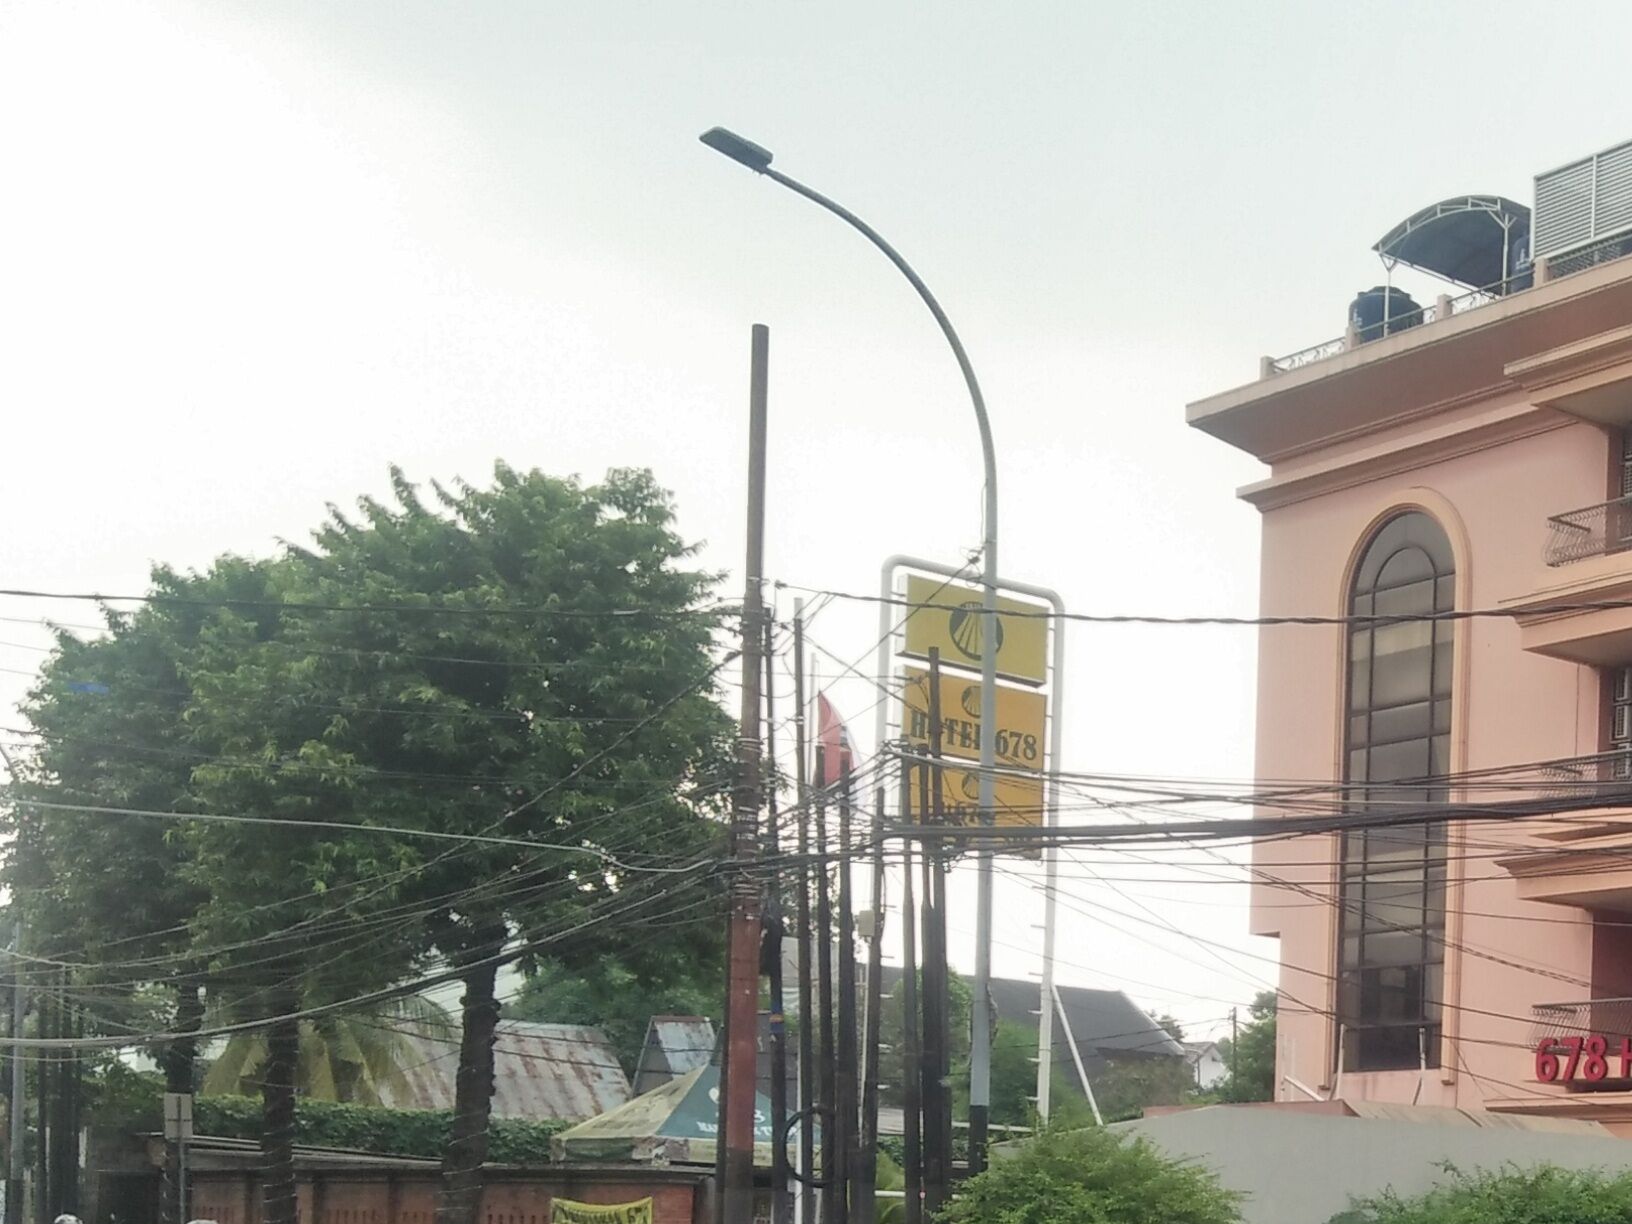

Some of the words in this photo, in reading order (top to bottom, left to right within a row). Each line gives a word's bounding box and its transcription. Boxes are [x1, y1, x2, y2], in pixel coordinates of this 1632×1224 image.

[911, 708, 981, 751] HTE
[995, 728, 1037, 760] 678
[1535, 1034, 1609, 1083] 678
